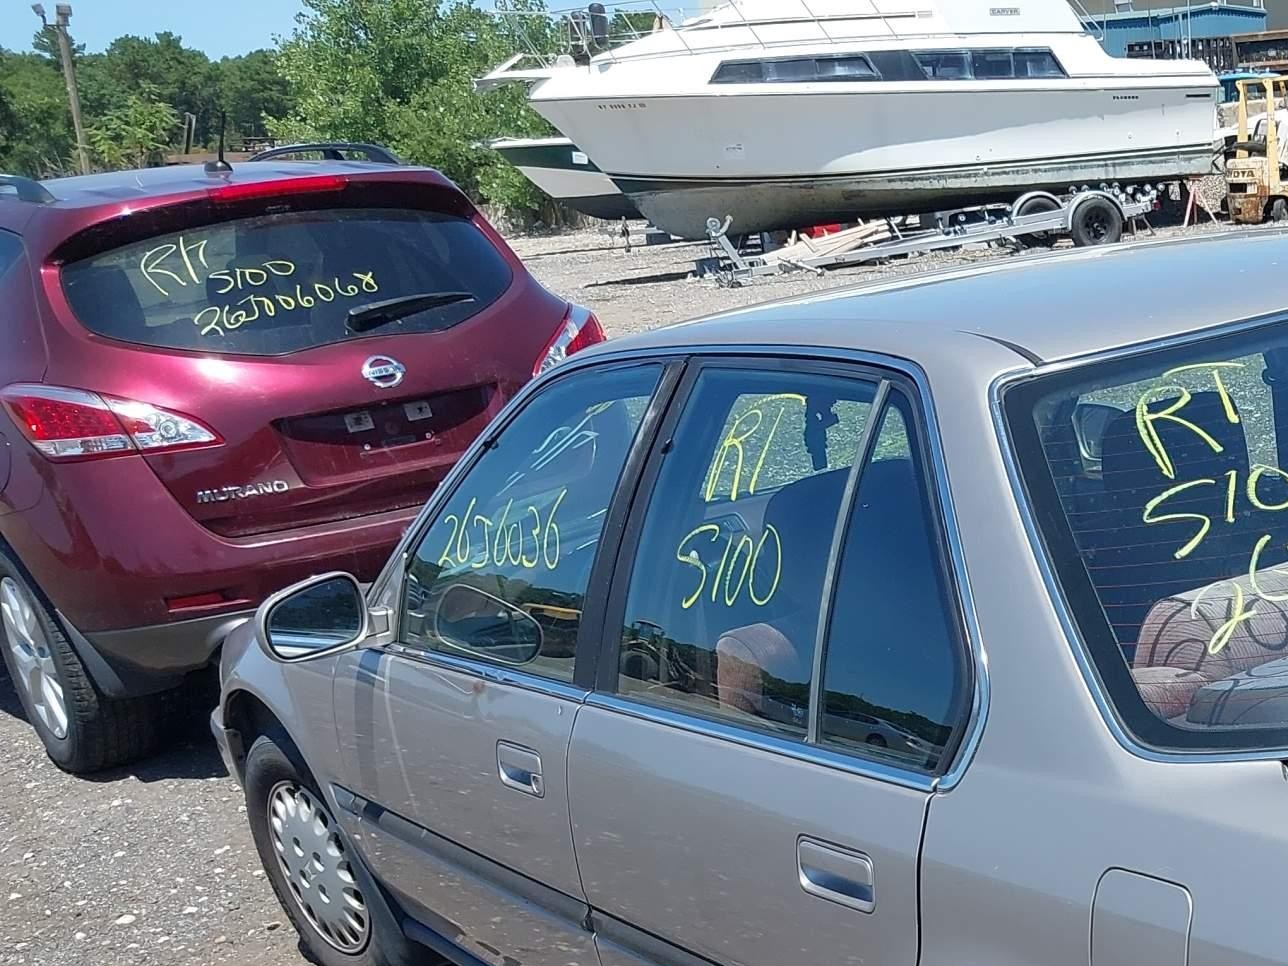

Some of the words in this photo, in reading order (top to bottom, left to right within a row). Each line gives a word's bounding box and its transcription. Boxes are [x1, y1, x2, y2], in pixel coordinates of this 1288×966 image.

[1136, 362, 1246, 479] RT
[197, 480, 288, 503] MURANO
[677, 523, 782, 608] S100
